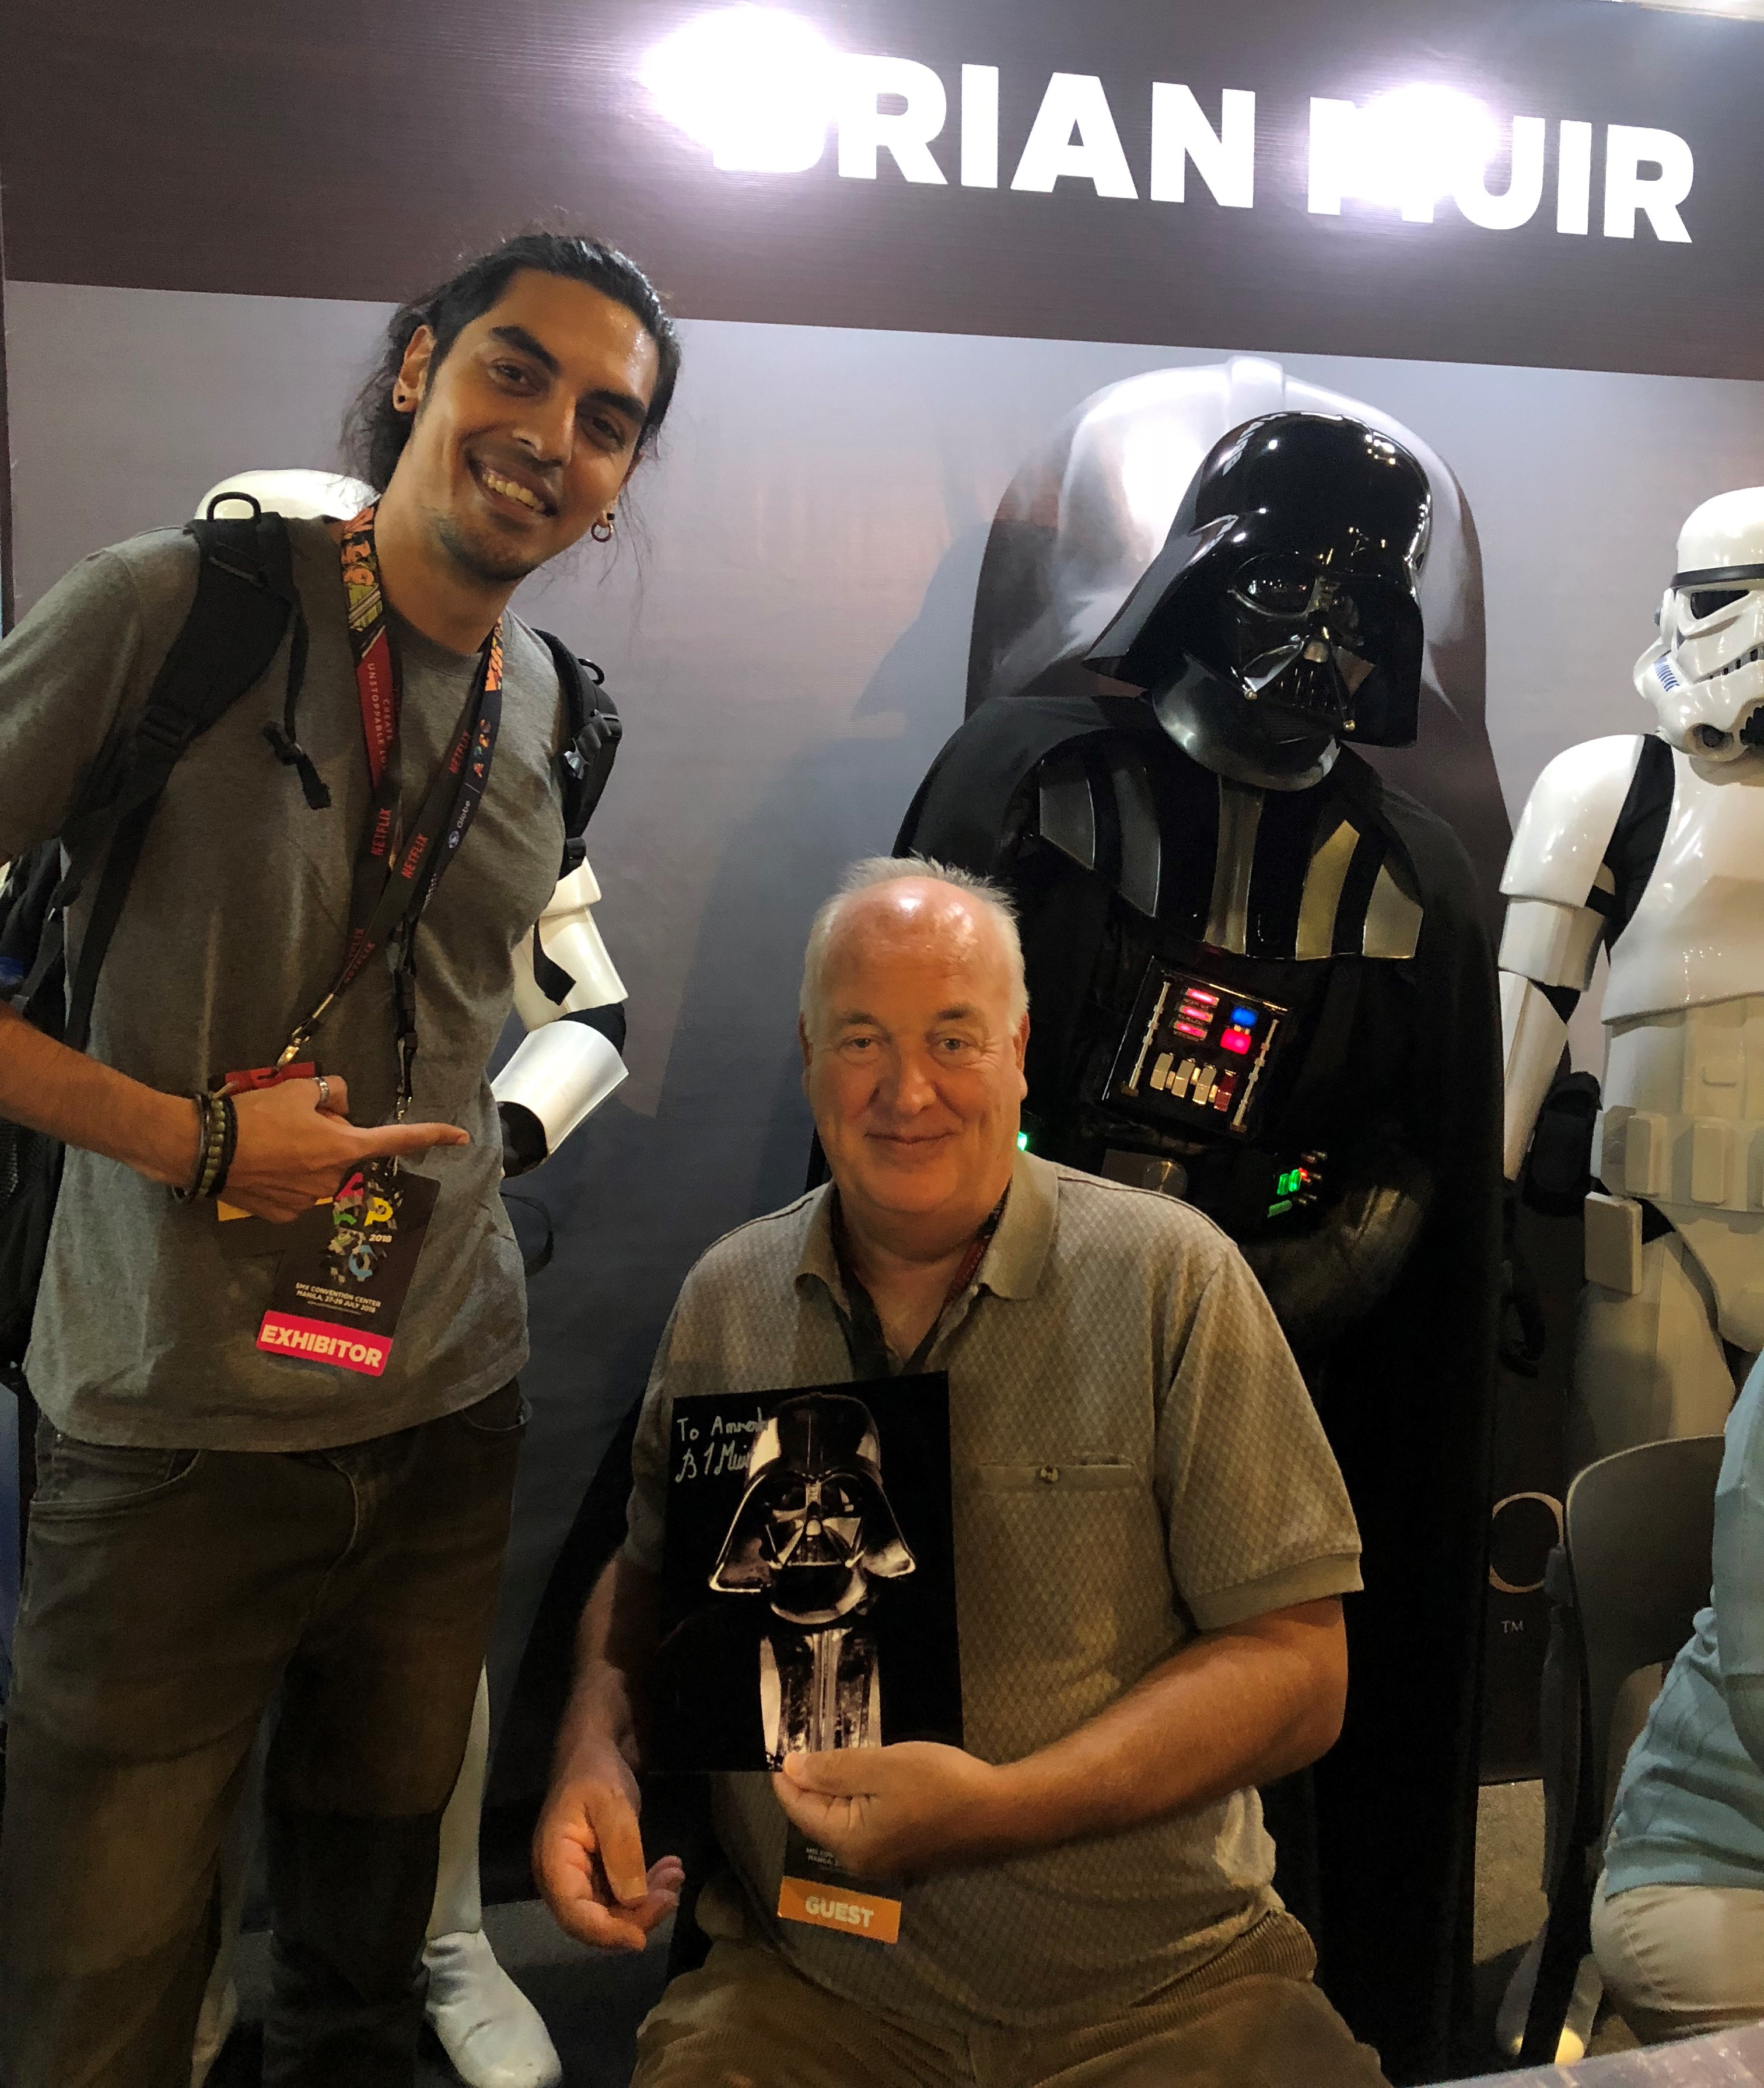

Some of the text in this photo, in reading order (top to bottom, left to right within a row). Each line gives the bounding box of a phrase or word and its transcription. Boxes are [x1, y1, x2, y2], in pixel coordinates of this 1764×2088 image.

[457, 800, 471, 828] Globe
[370, 808, 392, 856] NETFLIX
[401, 833, 428, 879] NETFLIX
[310, 1286, 354, 1300] CONVENTION
[355, 1296, 381, 1308] CENTER
[344, 1300, 360, 1309] JULY
[260, 1325, 382, 1368] EXHIBITOR
[677, 1417, 700, 1442] To
[1501, 1620, 1524, 1634] TM
[805, 1895, 874, 1928] GUEST
